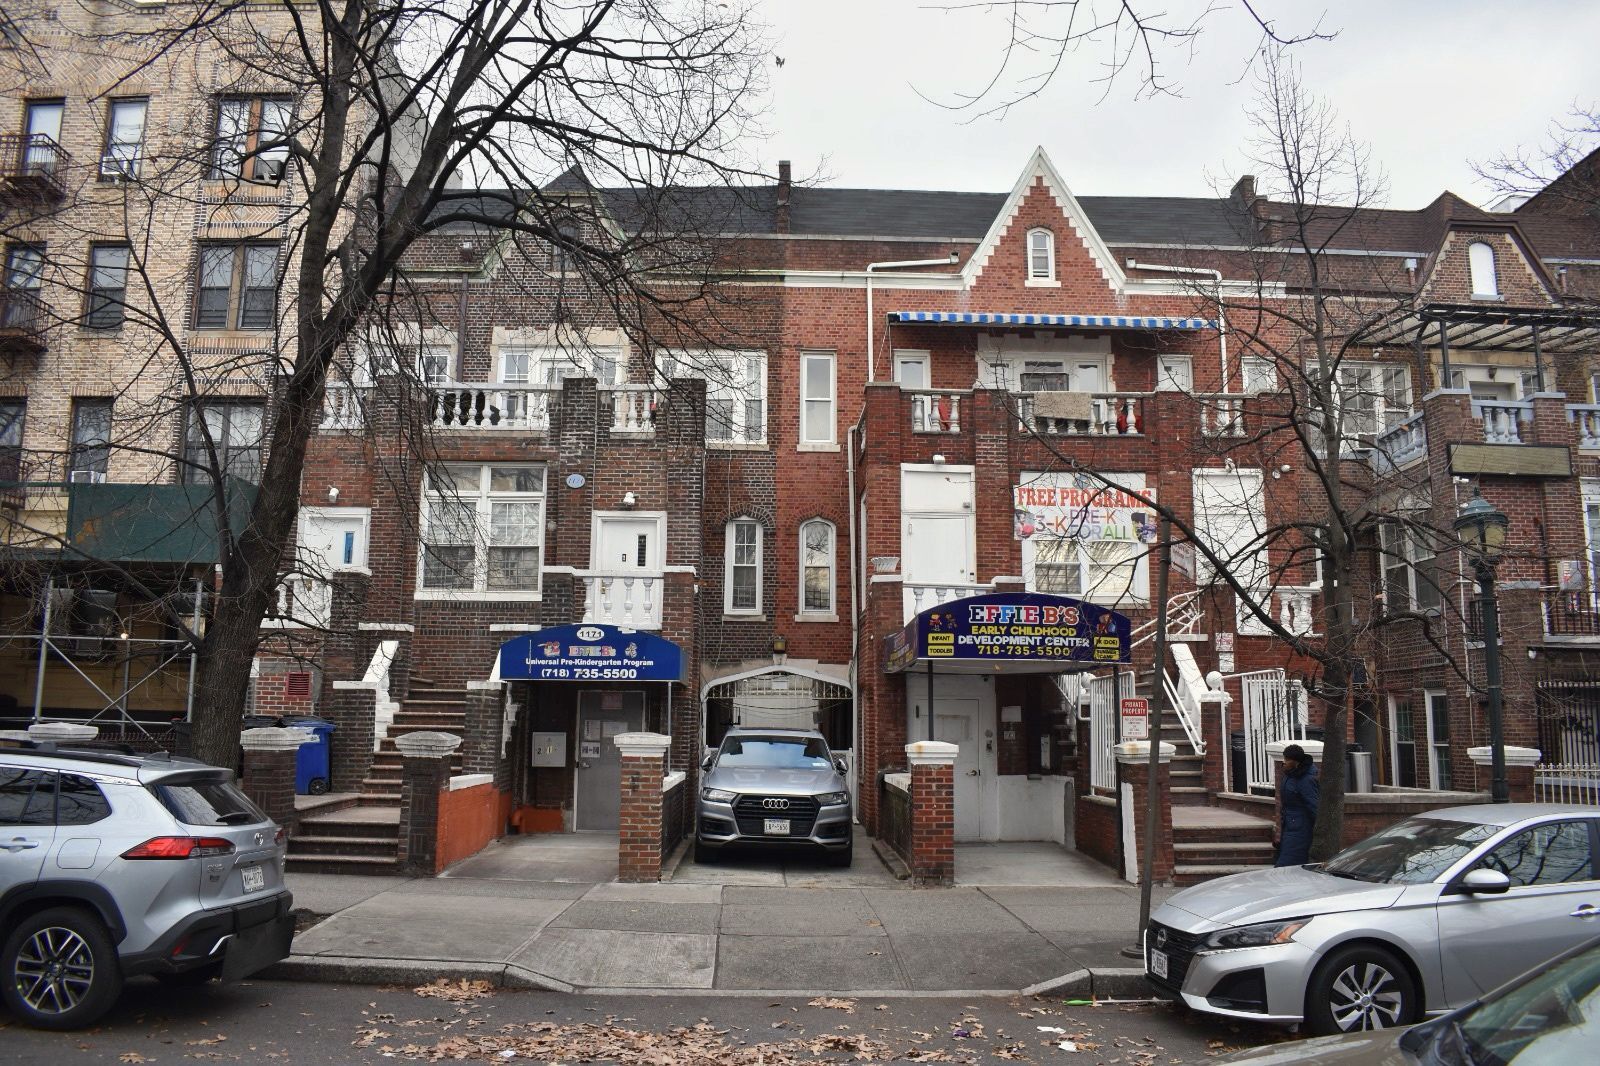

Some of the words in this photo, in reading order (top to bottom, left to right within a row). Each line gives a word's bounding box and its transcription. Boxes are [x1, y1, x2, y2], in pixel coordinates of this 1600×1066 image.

[1018, 487, 1057, 507] FREE
[1060, 487, 1152, 509] PROGRAMS
[1035, 515, 1068, 533] 3-K
[1070, 509, 1116, 525] PRE-K
[1070, 524, 1102, 541] FOR
[1103, 525, 1132, 541] ALL
[969, 605, 1039, 624] EFFIE
[1043, 606, 1080, 625] B'S
[971, 625, 1007, 635] EARLY
[1010, 626, 1077, 636] CHILDHOOD
[958, 635, 1043, 646] DEVELOPMENT
[1045, 636, 1090, 648] CENTER
[978, 645, 1071, 656] 718-735-5500
[526, 658, 559, 666] Universal
[561, 658, 622, 667] Pre-Kindergarten
[623, 659, 654, 668] Program
[541, 668, 570, 678] (718)
[574, 668, 637, 679] 735-5500
